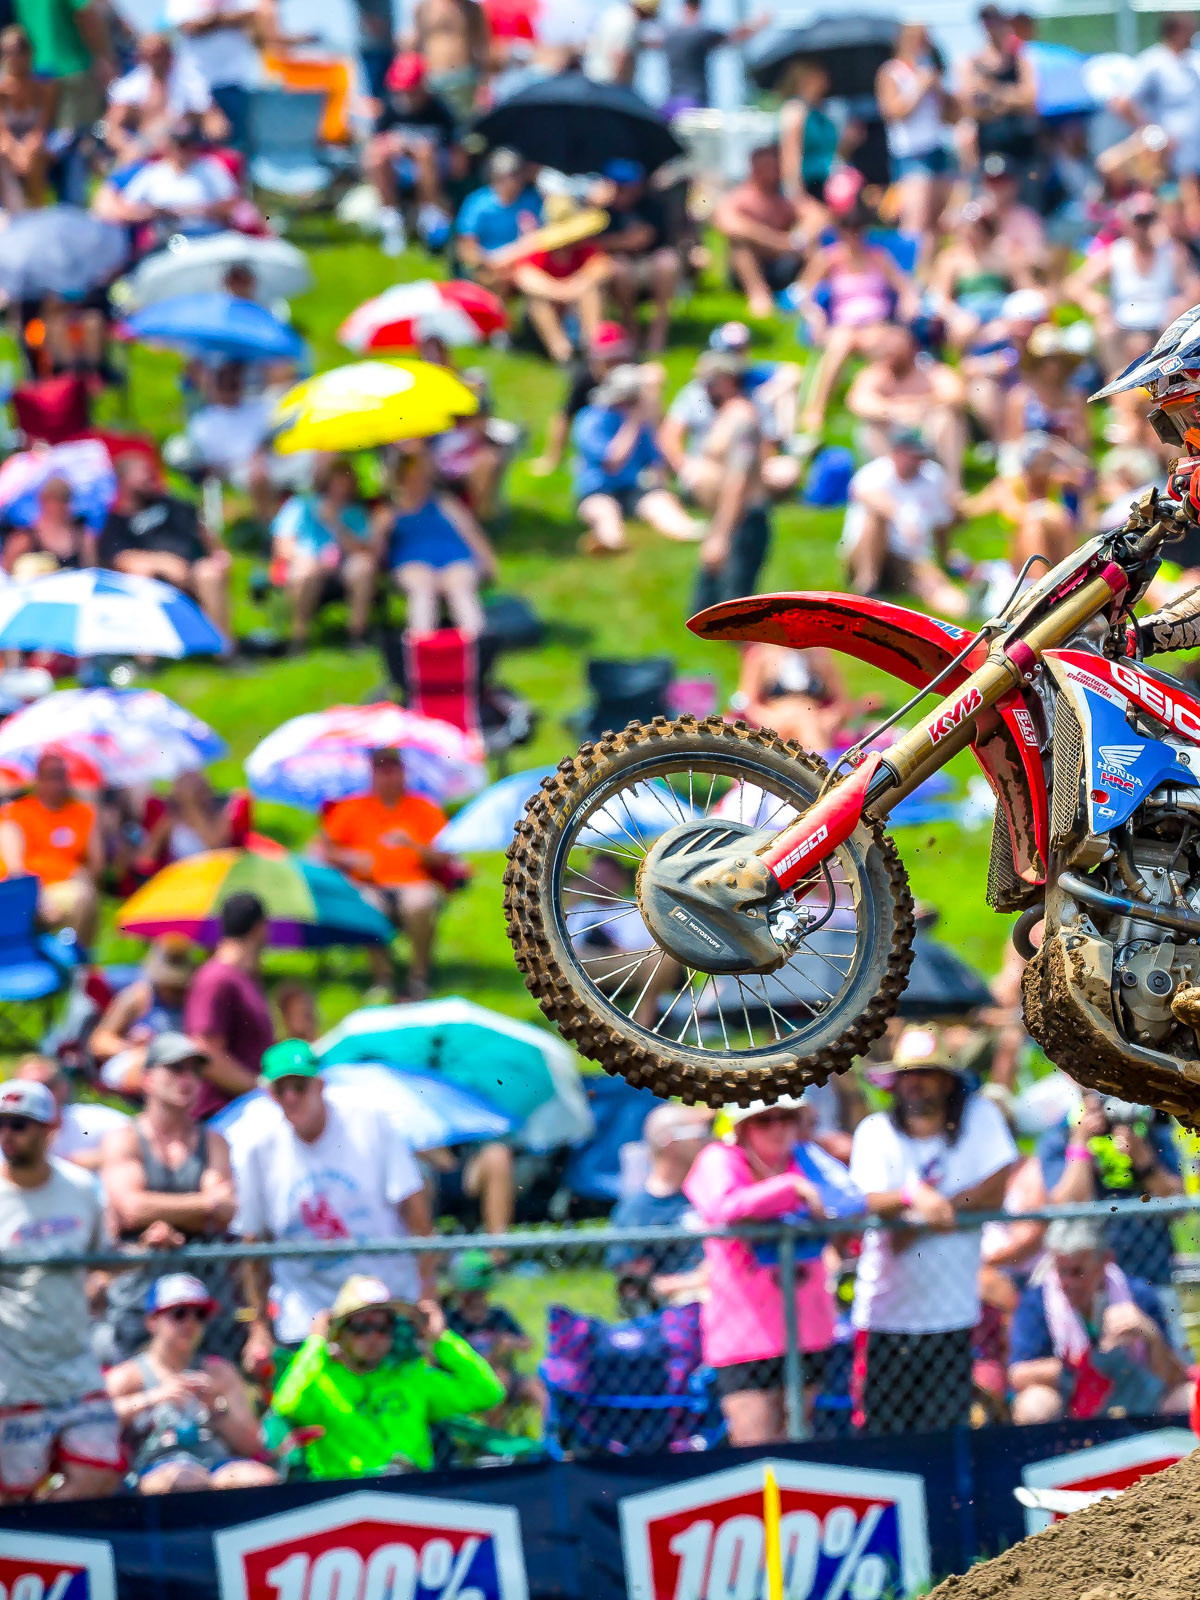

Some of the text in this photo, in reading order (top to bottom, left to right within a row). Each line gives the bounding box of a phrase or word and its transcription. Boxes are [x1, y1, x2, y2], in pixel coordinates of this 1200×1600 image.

[1161, 357, 1182, 374] 100%
[926, 687, 983, 746] KYB
[1096, 761, 1143, 788] HONDA
[1100, 772, 1135, 796] HRC
[688, 921, 721, 949] MOTOSTUFF
[669, 1504, 886, 1600] 100%
